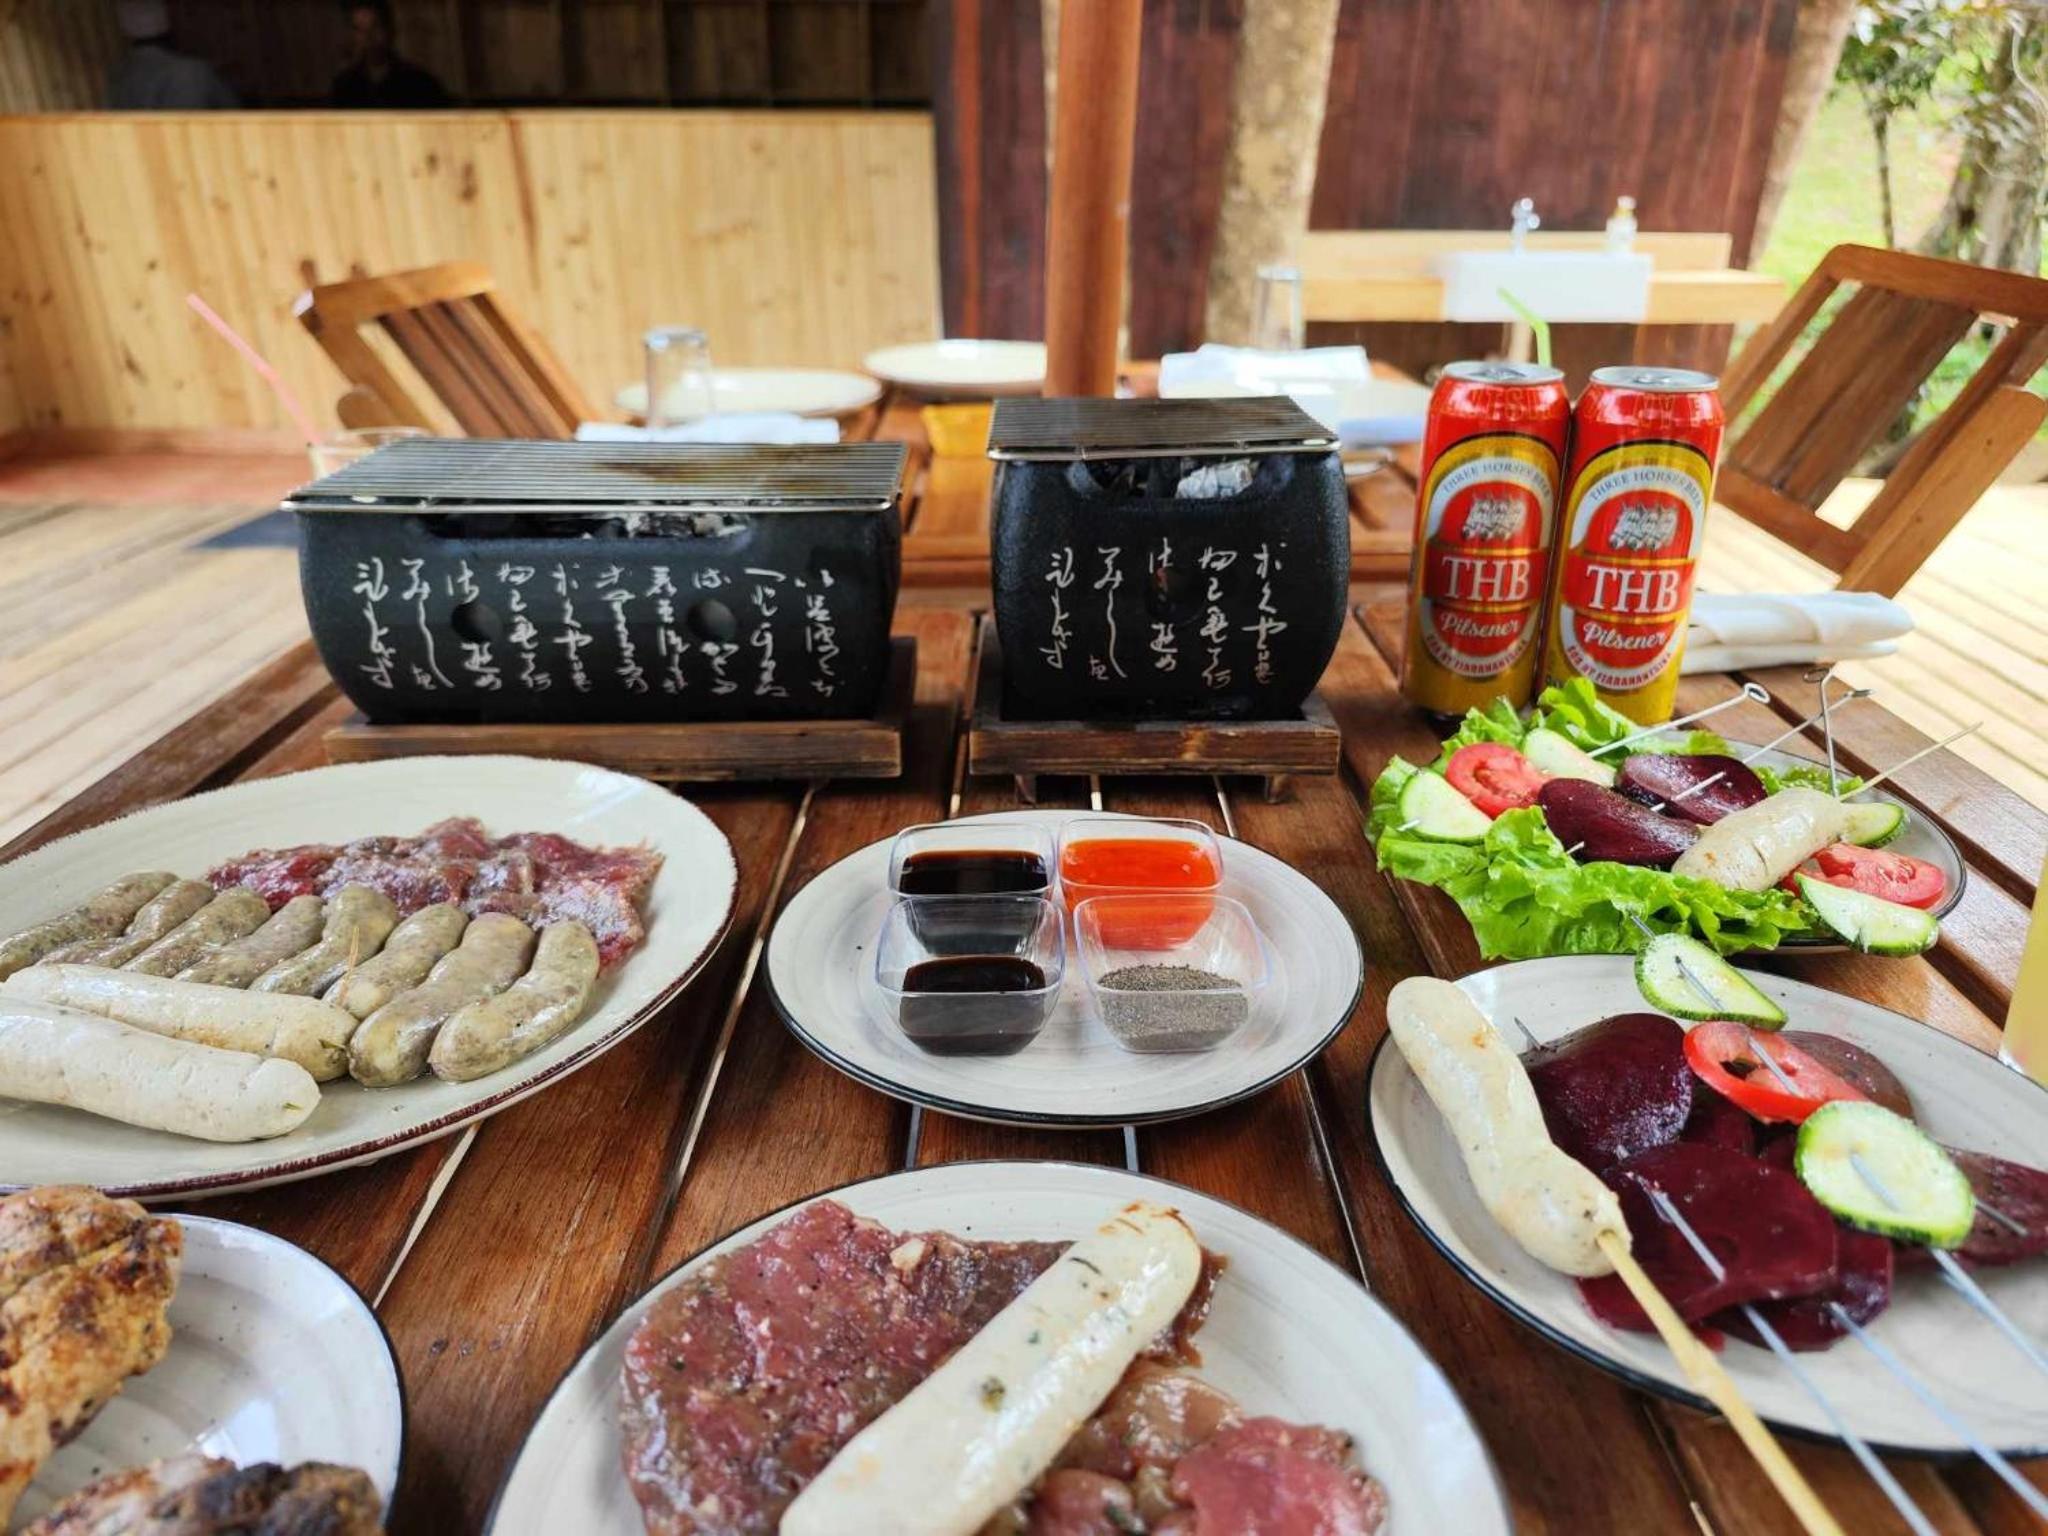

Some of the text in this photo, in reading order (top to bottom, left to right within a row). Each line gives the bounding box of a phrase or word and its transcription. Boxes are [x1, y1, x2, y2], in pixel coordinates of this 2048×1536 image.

[1443, 467, 1479, 493] THREE
[1590, 474, 1630, 501] THREE
[1441, 556, 1531, 602] THB
[1586, 564, 1681, 614] THB
[1440, 611, 1520, 639] Pilsener
[1583, 621, 1666, 650] Pilsener
